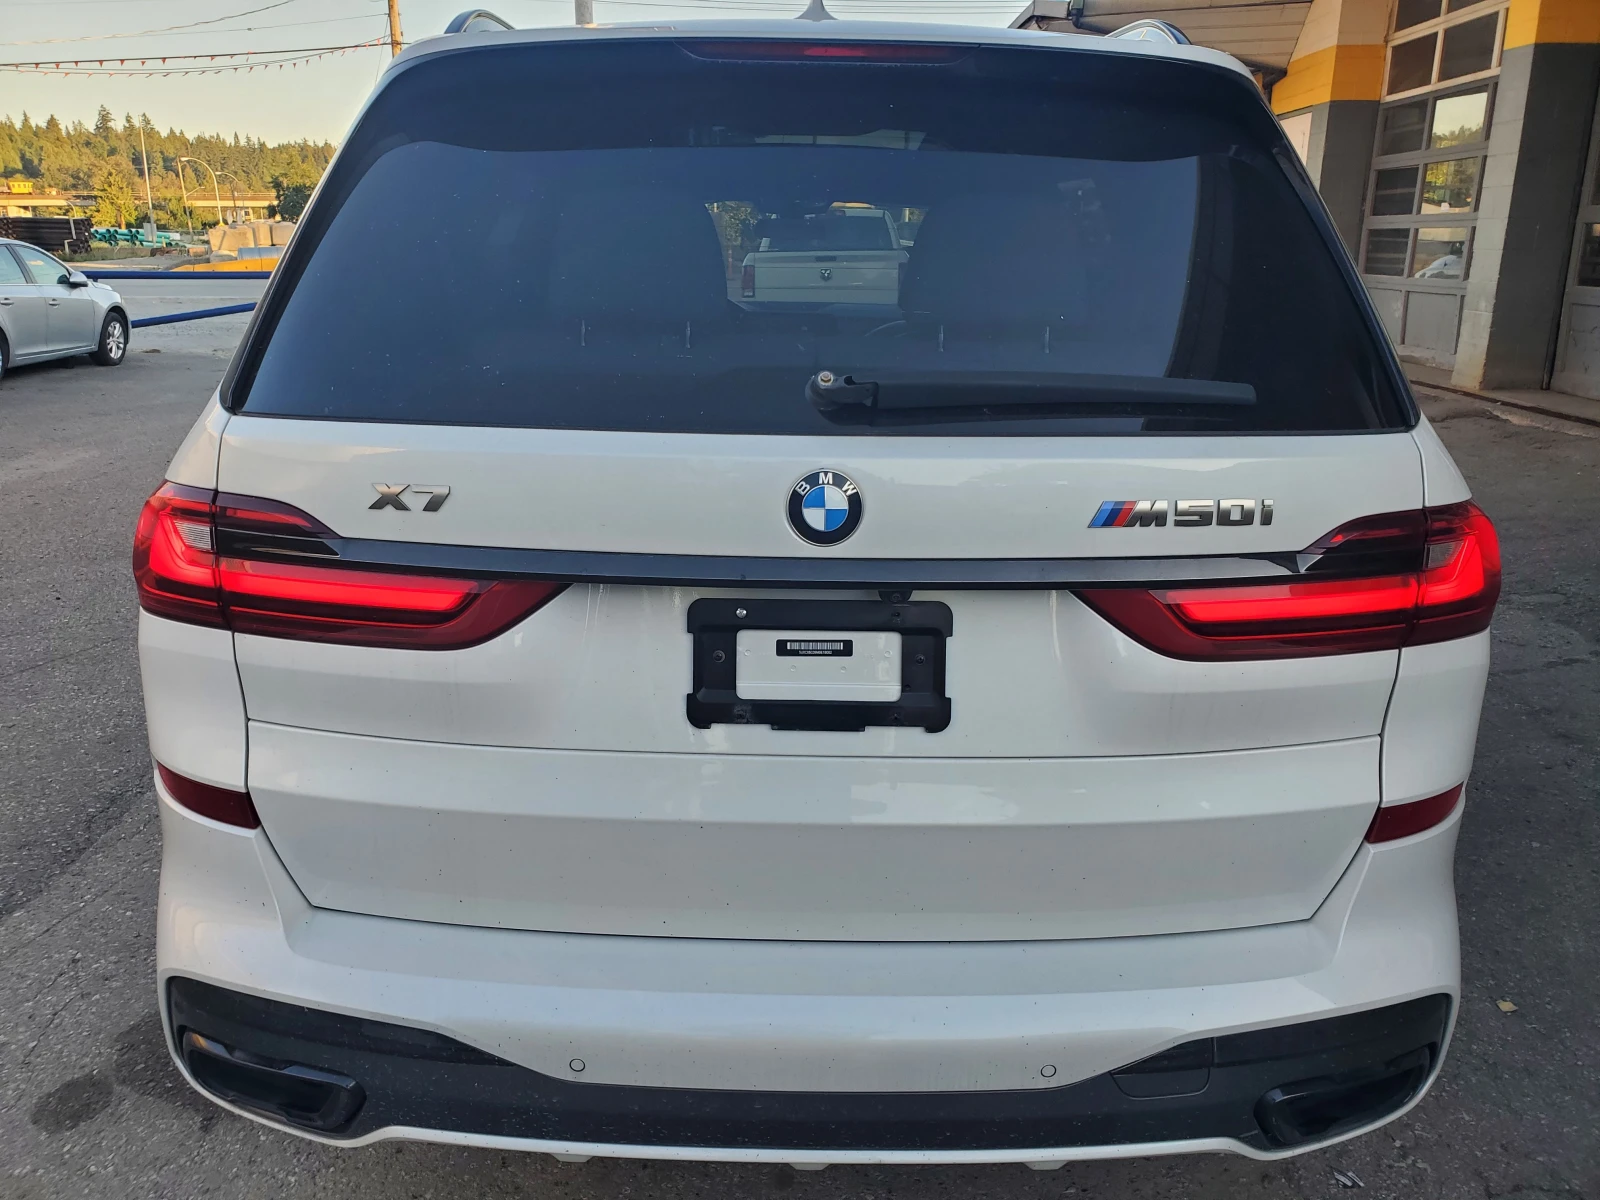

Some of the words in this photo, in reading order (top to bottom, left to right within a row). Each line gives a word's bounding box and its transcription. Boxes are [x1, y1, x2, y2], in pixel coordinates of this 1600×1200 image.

[368, 483, 451, 513] X7
[795, 472, 857, 496] BMW
[1123, 499, 1274, 527] M50i
